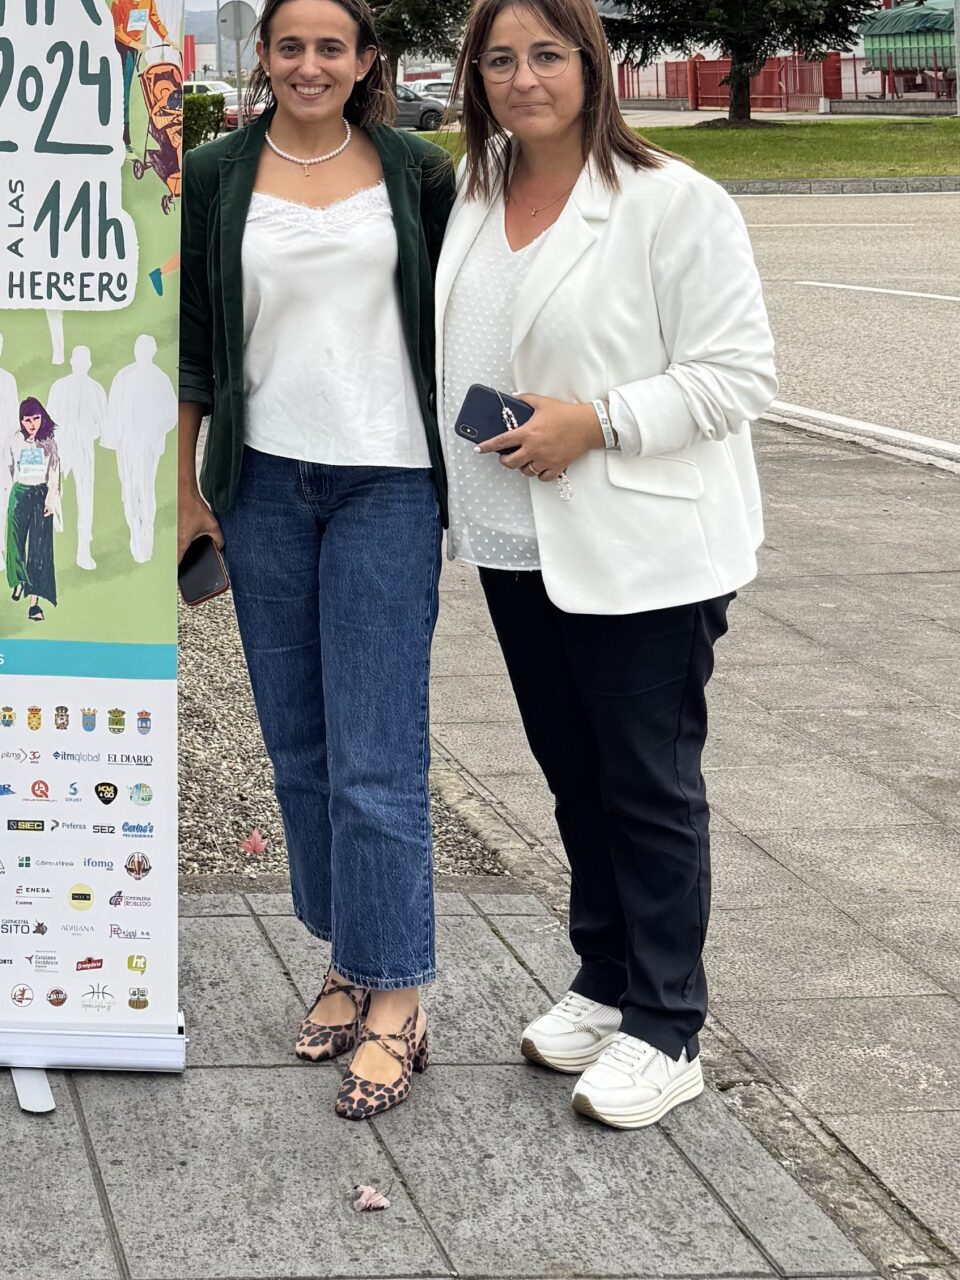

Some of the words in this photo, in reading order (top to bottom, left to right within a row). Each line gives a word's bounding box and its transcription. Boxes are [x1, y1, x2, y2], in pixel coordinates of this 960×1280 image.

[33, 179, 127, 260] 11h
[7, 270, 128, 302] HERRERO
[60, 751, 101, 763] itmglobal
[107, 754, 118, 763] EL
[120, 754, 153, 764] DIARIO
[17, 821, 43, 830] SIEC
[92, 824, 116, 834] SER
[83, 858, 114, 869] ifomo
[0, 924, 30, 935] SITO
